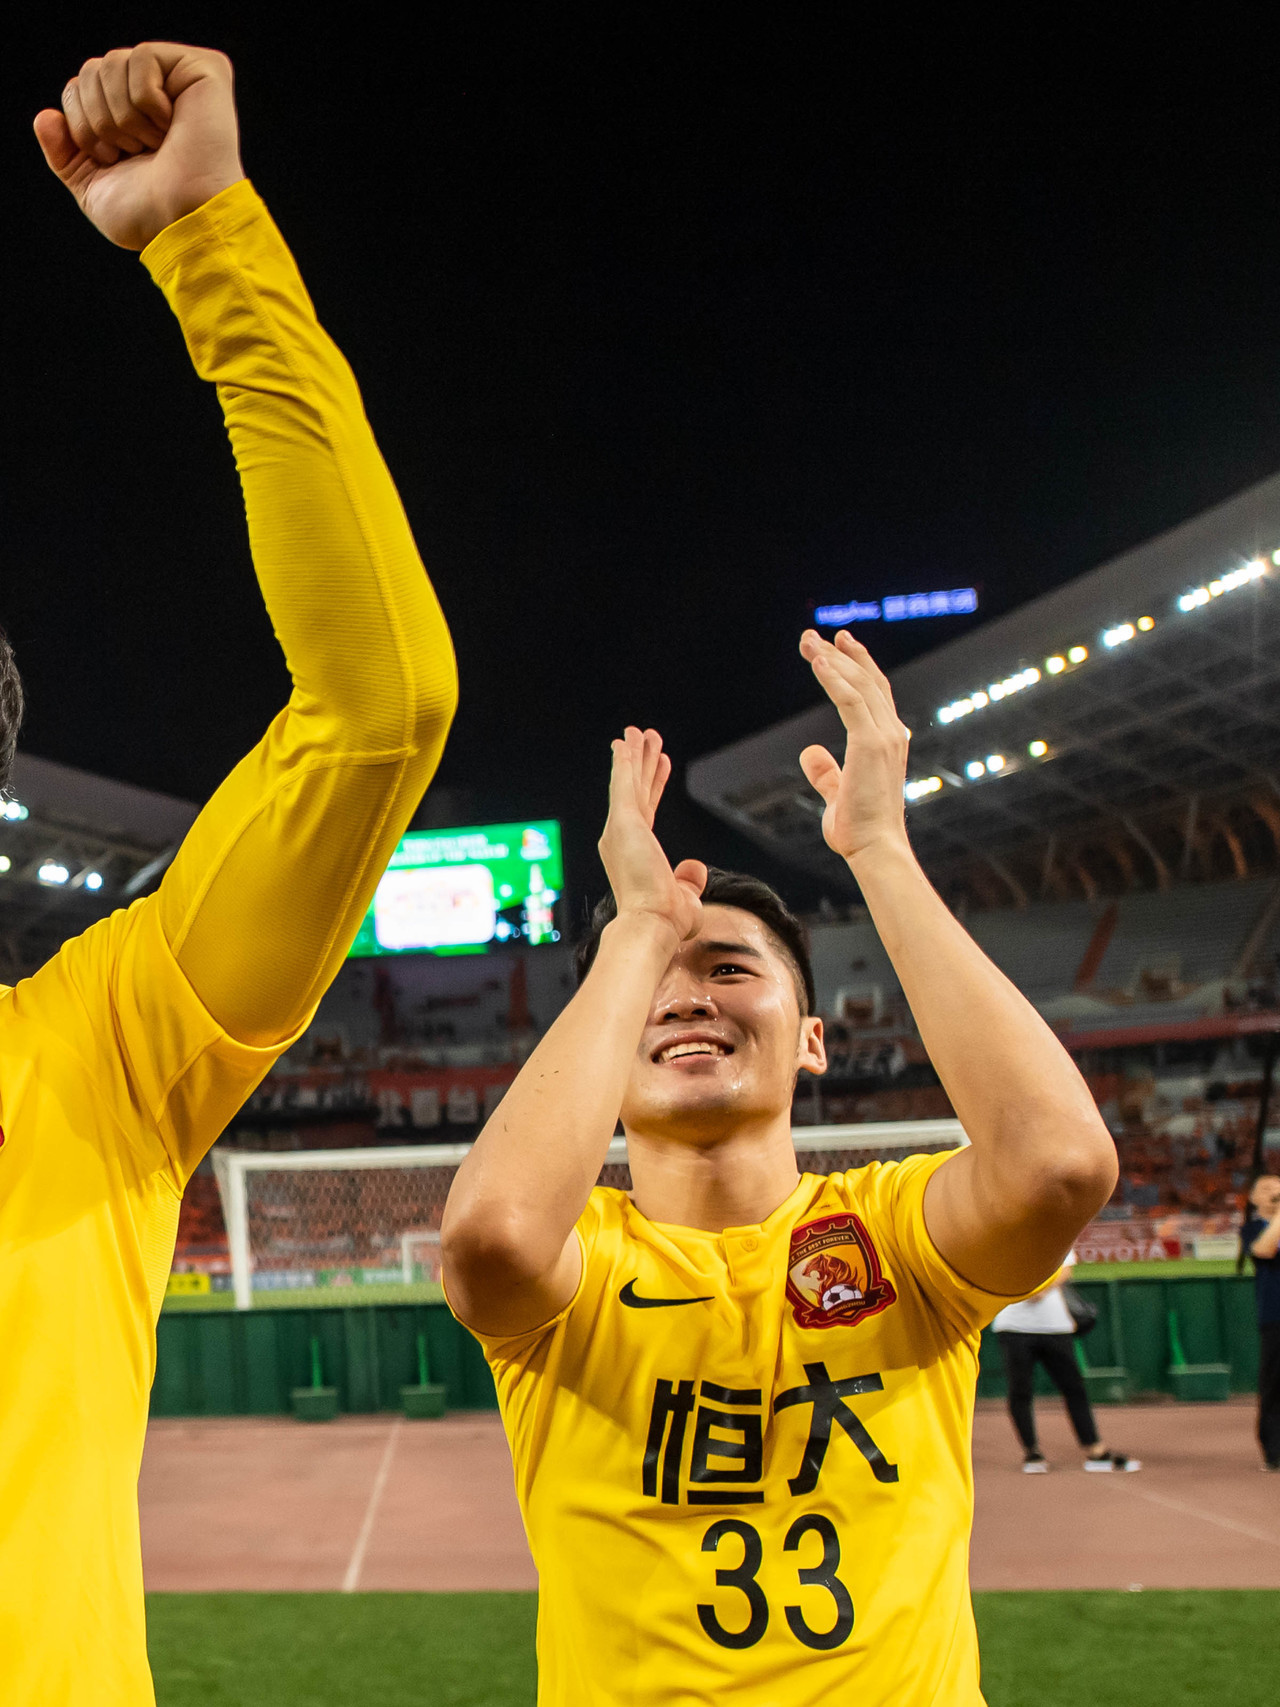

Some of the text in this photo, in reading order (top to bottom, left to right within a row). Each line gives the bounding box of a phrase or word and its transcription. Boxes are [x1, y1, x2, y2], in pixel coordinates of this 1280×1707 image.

[796, 1248, 807, 1258] THE
[807, 1241, 822, 1252] BEST
[822, 1235, 850, 1245] FOREVER
[642, 1361, 899, 1505] 恒大
[696, 1513, 855, 1651] 33
